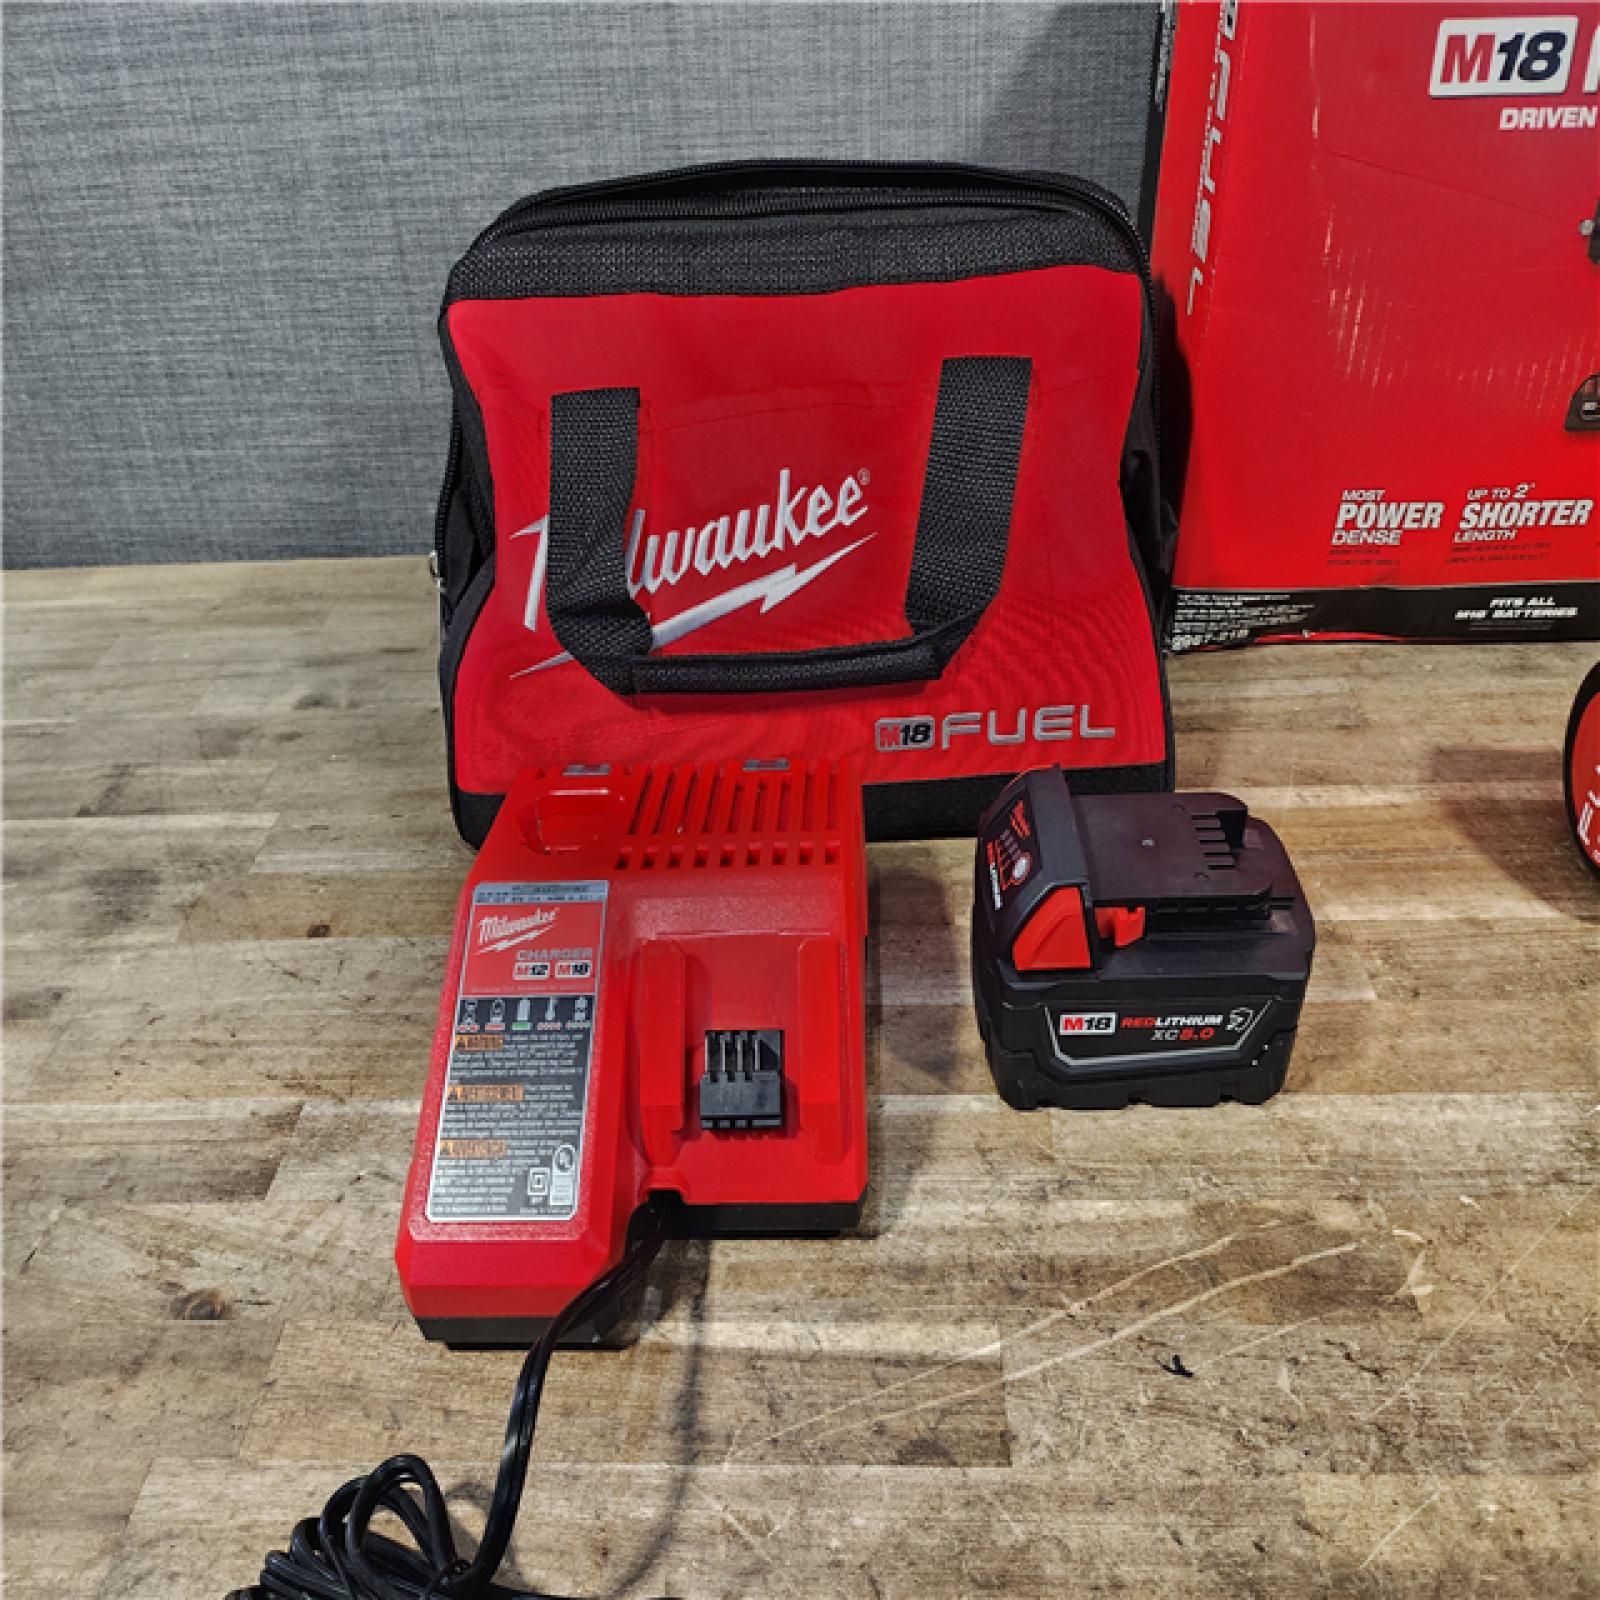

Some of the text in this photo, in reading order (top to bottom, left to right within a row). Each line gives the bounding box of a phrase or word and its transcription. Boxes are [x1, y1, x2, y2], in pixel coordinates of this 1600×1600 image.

[1438, 30, 1569, 85] M18
[1499, 105, 1598, 131] DRIVEN
[1342, 489, 1385, 500] MOST
[1336, 502, 1445, 529] POWER
[1459, 499, 1594, 529] SHORTER
[509, 467, 869, 631] lwaukee
[1331, 530, 1403, 545] DENSE
[1453, 530, 1518, 543] LENGTH
[877, 705, 1116, 750] M18 FUEL
[477, 907, 557, 945] Milwaukee
[516, 948, 593, 961] CHARGER
[1062, 1014, 1224, 1033] M18 REDLITHIUM
